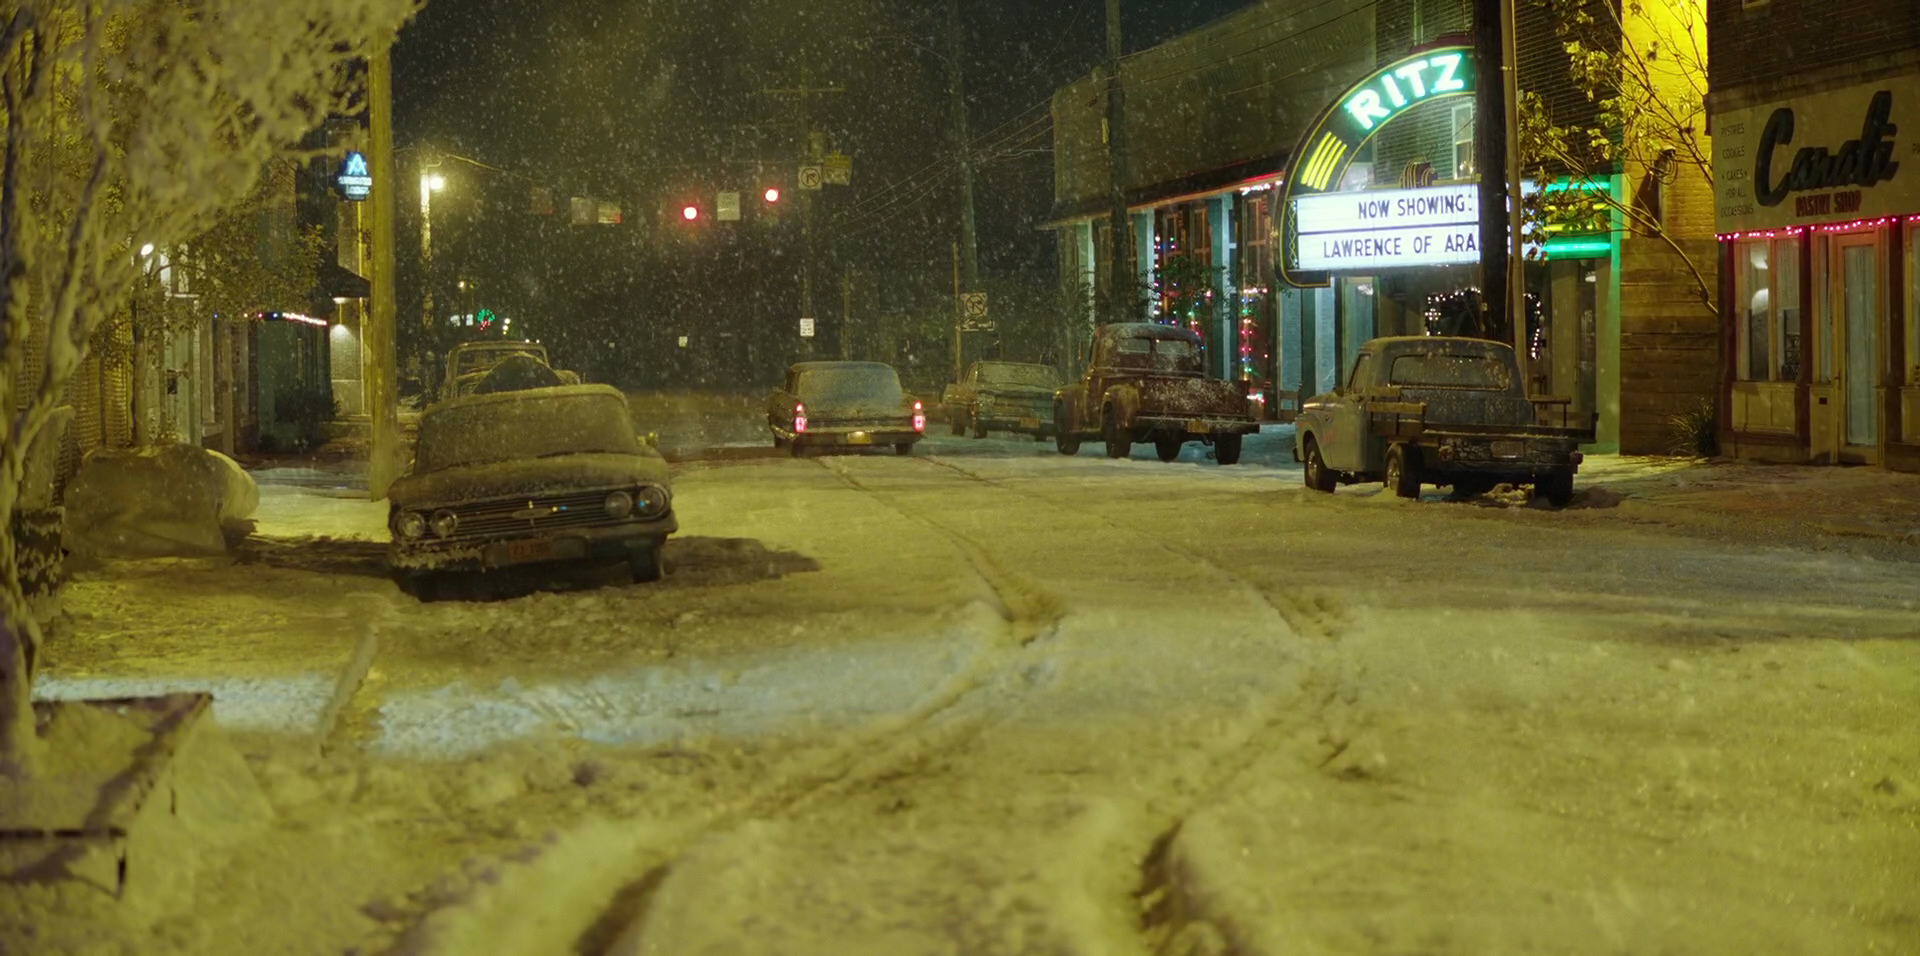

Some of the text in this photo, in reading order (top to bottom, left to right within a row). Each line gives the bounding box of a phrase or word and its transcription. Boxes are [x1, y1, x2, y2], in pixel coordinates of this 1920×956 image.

[1343, 53, 1464, 129] RITZ
[1358, 194, 1472, 219] NOW SHOWING:
[1796, 190, 1862, 217] PASTRY SHOP
[1323, 237, 1401, 258] LAWRENCE
[1413, 236, 1432, 254] OF
